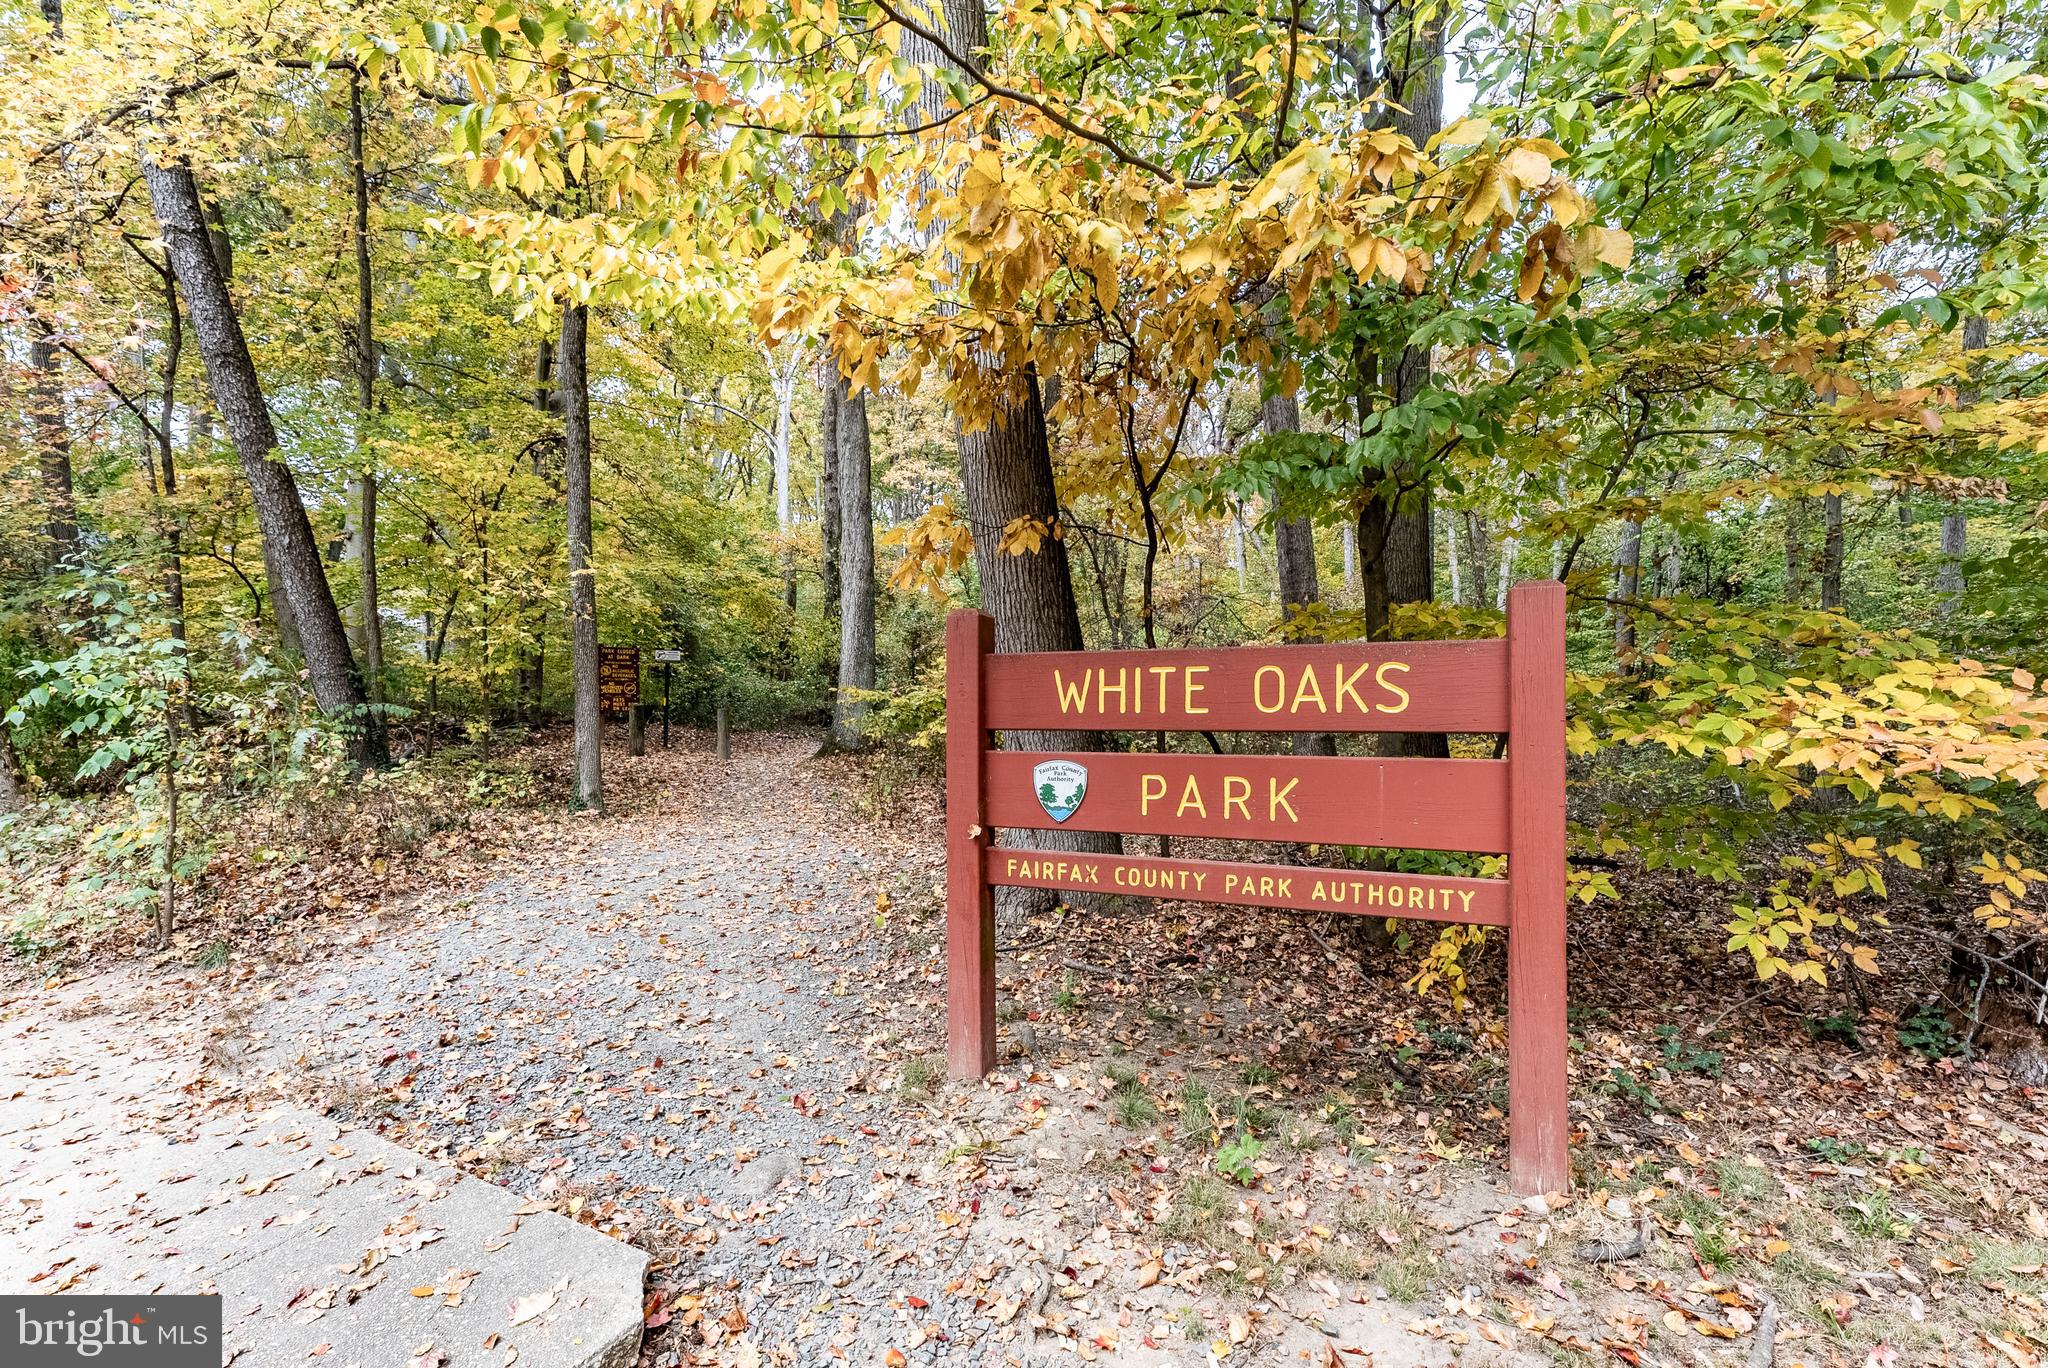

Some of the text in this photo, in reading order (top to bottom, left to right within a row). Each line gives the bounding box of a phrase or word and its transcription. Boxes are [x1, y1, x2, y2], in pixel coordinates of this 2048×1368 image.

[1053, 661, 1411, 714] WHITE OAKS
[1038, 765, 1083, 776] Fairfax County
[1141, 774, 1299, 823] PARK
[1005, 858, 1476, 913] FAIRFAX COUNTY PARK AUTHORITY
